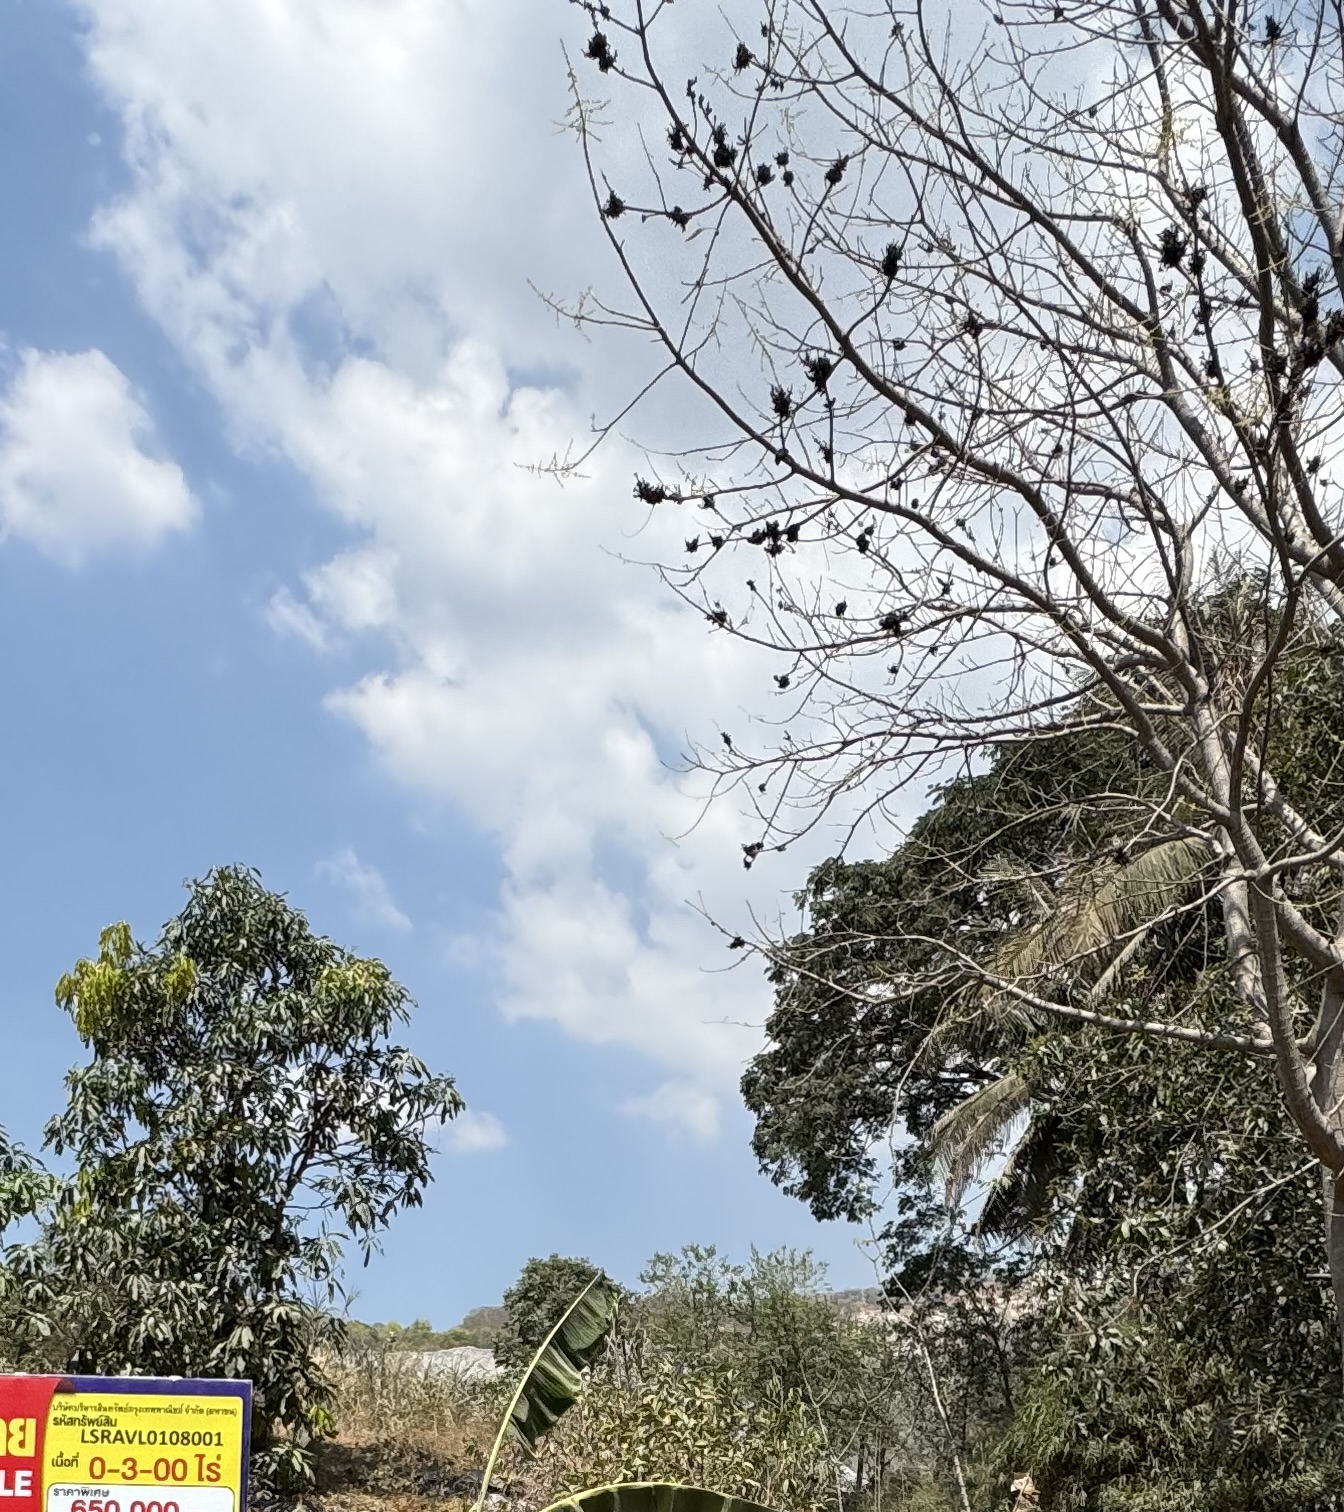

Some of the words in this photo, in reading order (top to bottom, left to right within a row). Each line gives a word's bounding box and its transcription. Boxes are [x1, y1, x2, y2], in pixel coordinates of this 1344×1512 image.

[52, 1414, 118, 1427] รหัสทรัพย์สิน
[80, 1429, 224, 1447] LSRAVL0108001
[51, 1452, 80, 1468] เนื้อที่
[88, 1456, 188, 1482] 0-3-00
[194, 1453, 222, 1482] ไร่
[53, 1486, 110, 1498] ราคาพิเศษ
